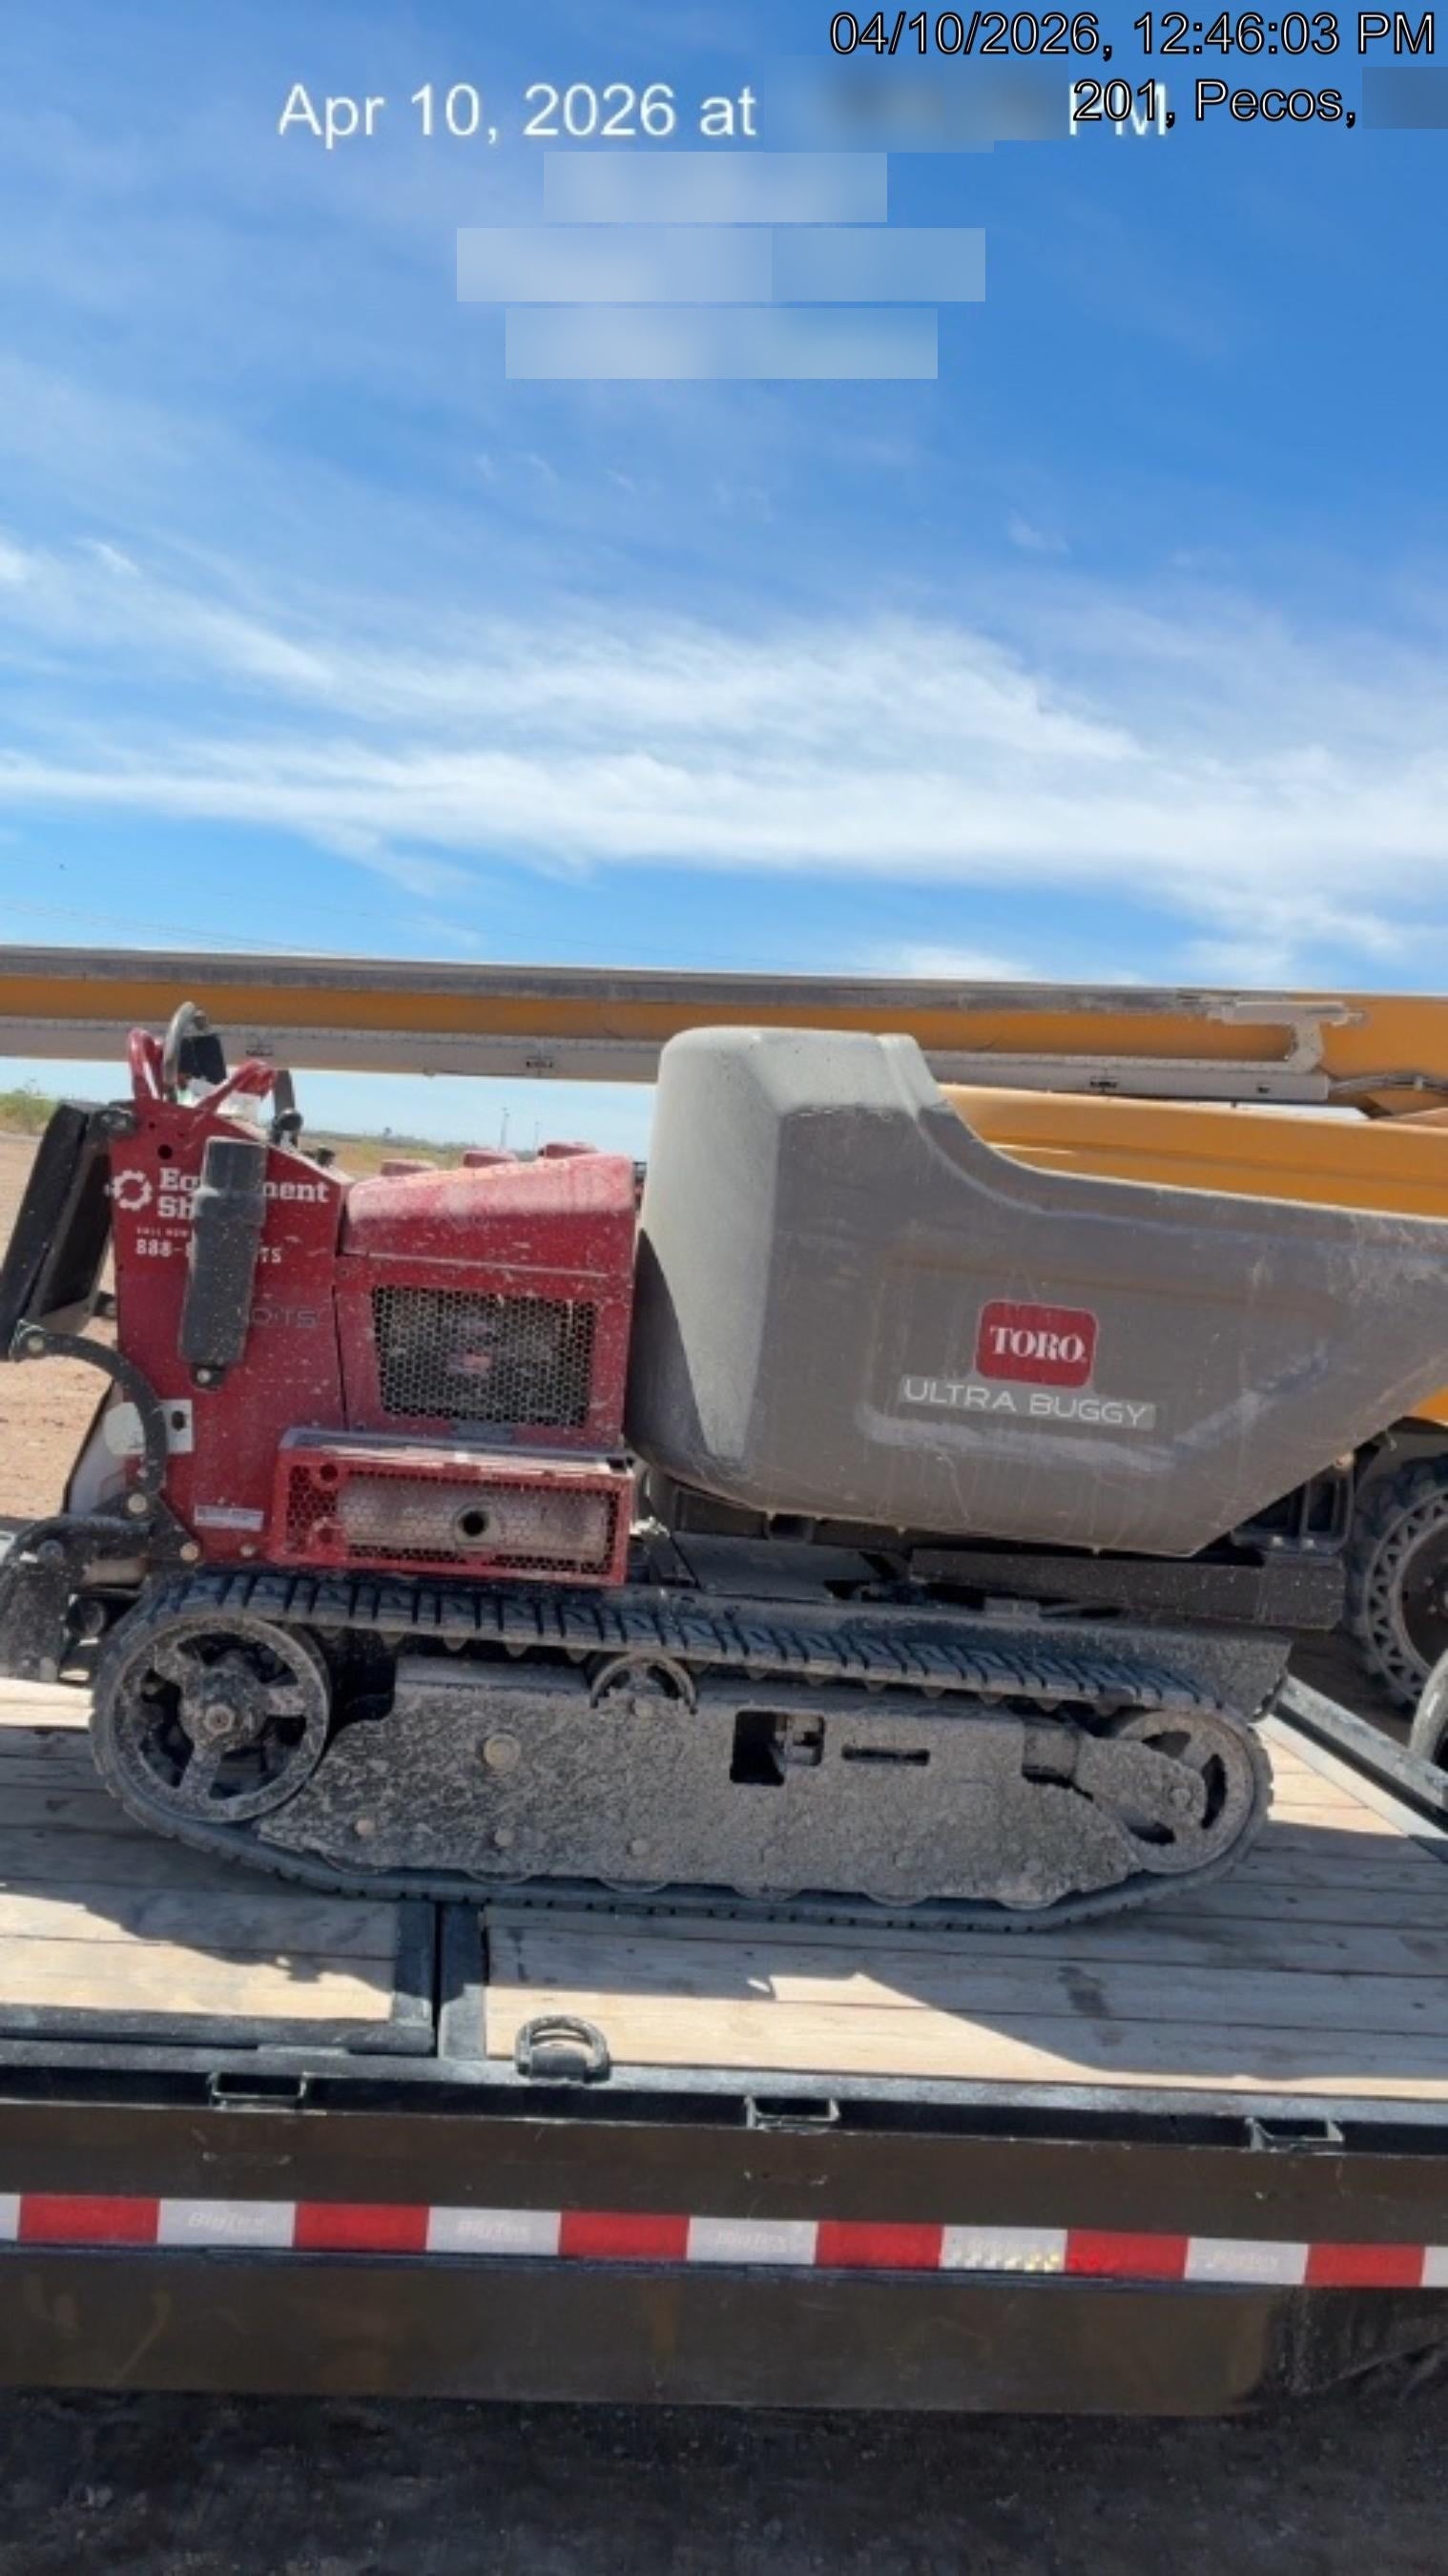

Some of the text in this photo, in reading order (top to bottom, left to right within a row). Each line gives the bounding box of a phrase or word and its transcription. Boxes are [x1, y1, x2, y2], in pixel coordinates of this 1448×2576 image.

[989, 1325, 1086, 1362] TORO
[905, 1379, 1147, 1426] ULTRA BUGGY
